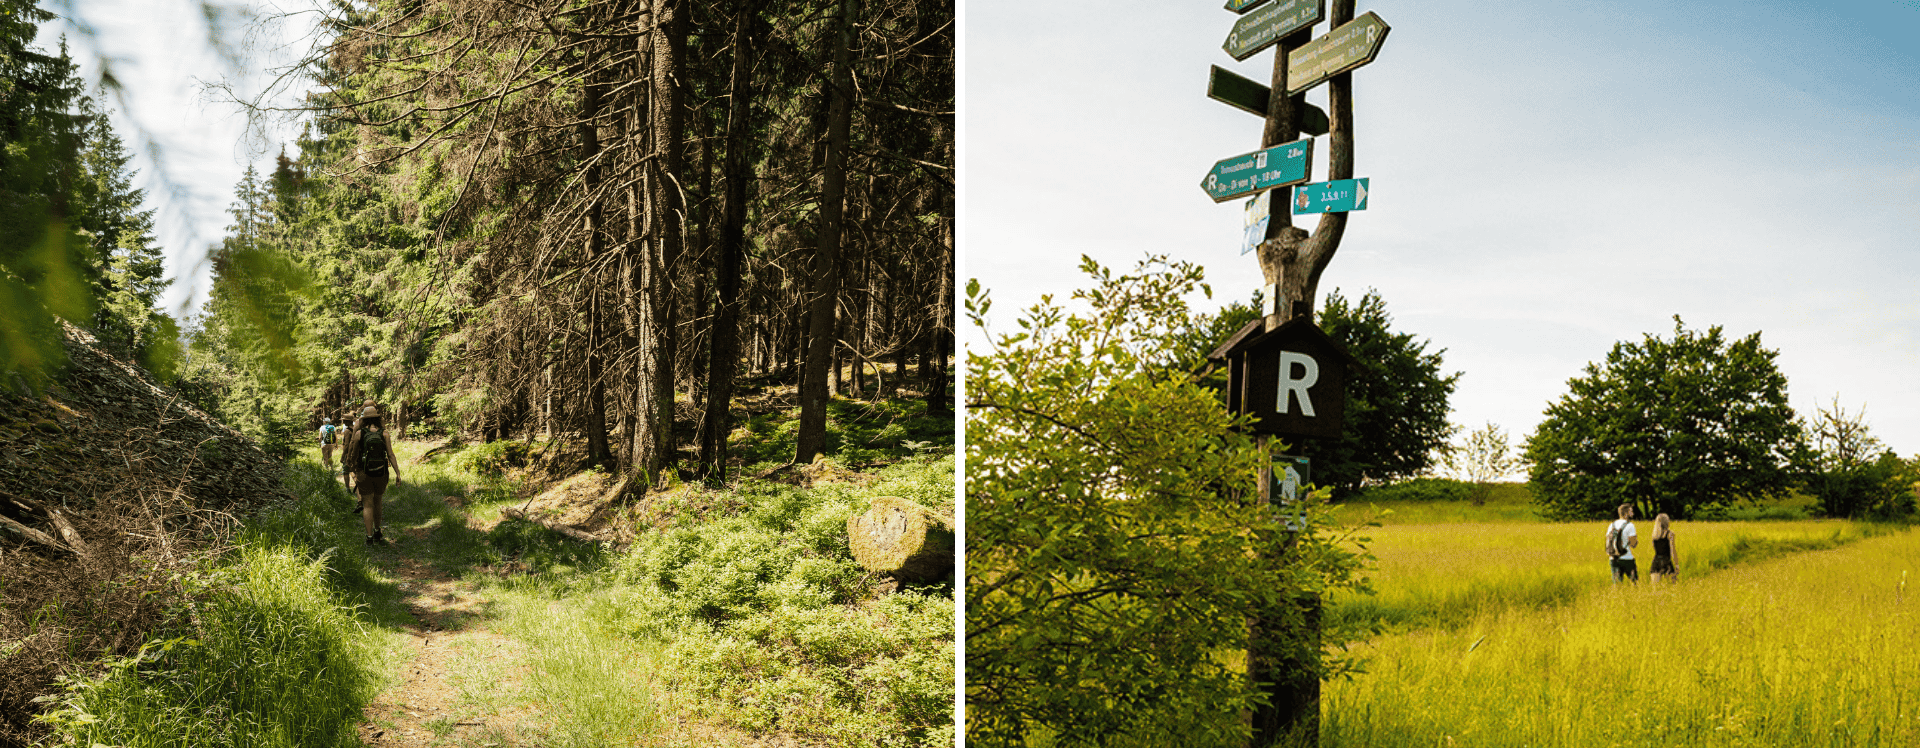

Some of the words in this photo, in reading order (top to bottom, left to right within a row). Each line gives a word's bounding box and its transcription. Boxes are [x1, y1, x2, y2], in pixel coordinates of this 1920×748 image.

[1229, 32, 1238, 50] R
[1366, 23, 1376, 44] R
[1208, 173, 1218, 190] R
[1276, 350, 1319, 417] R
